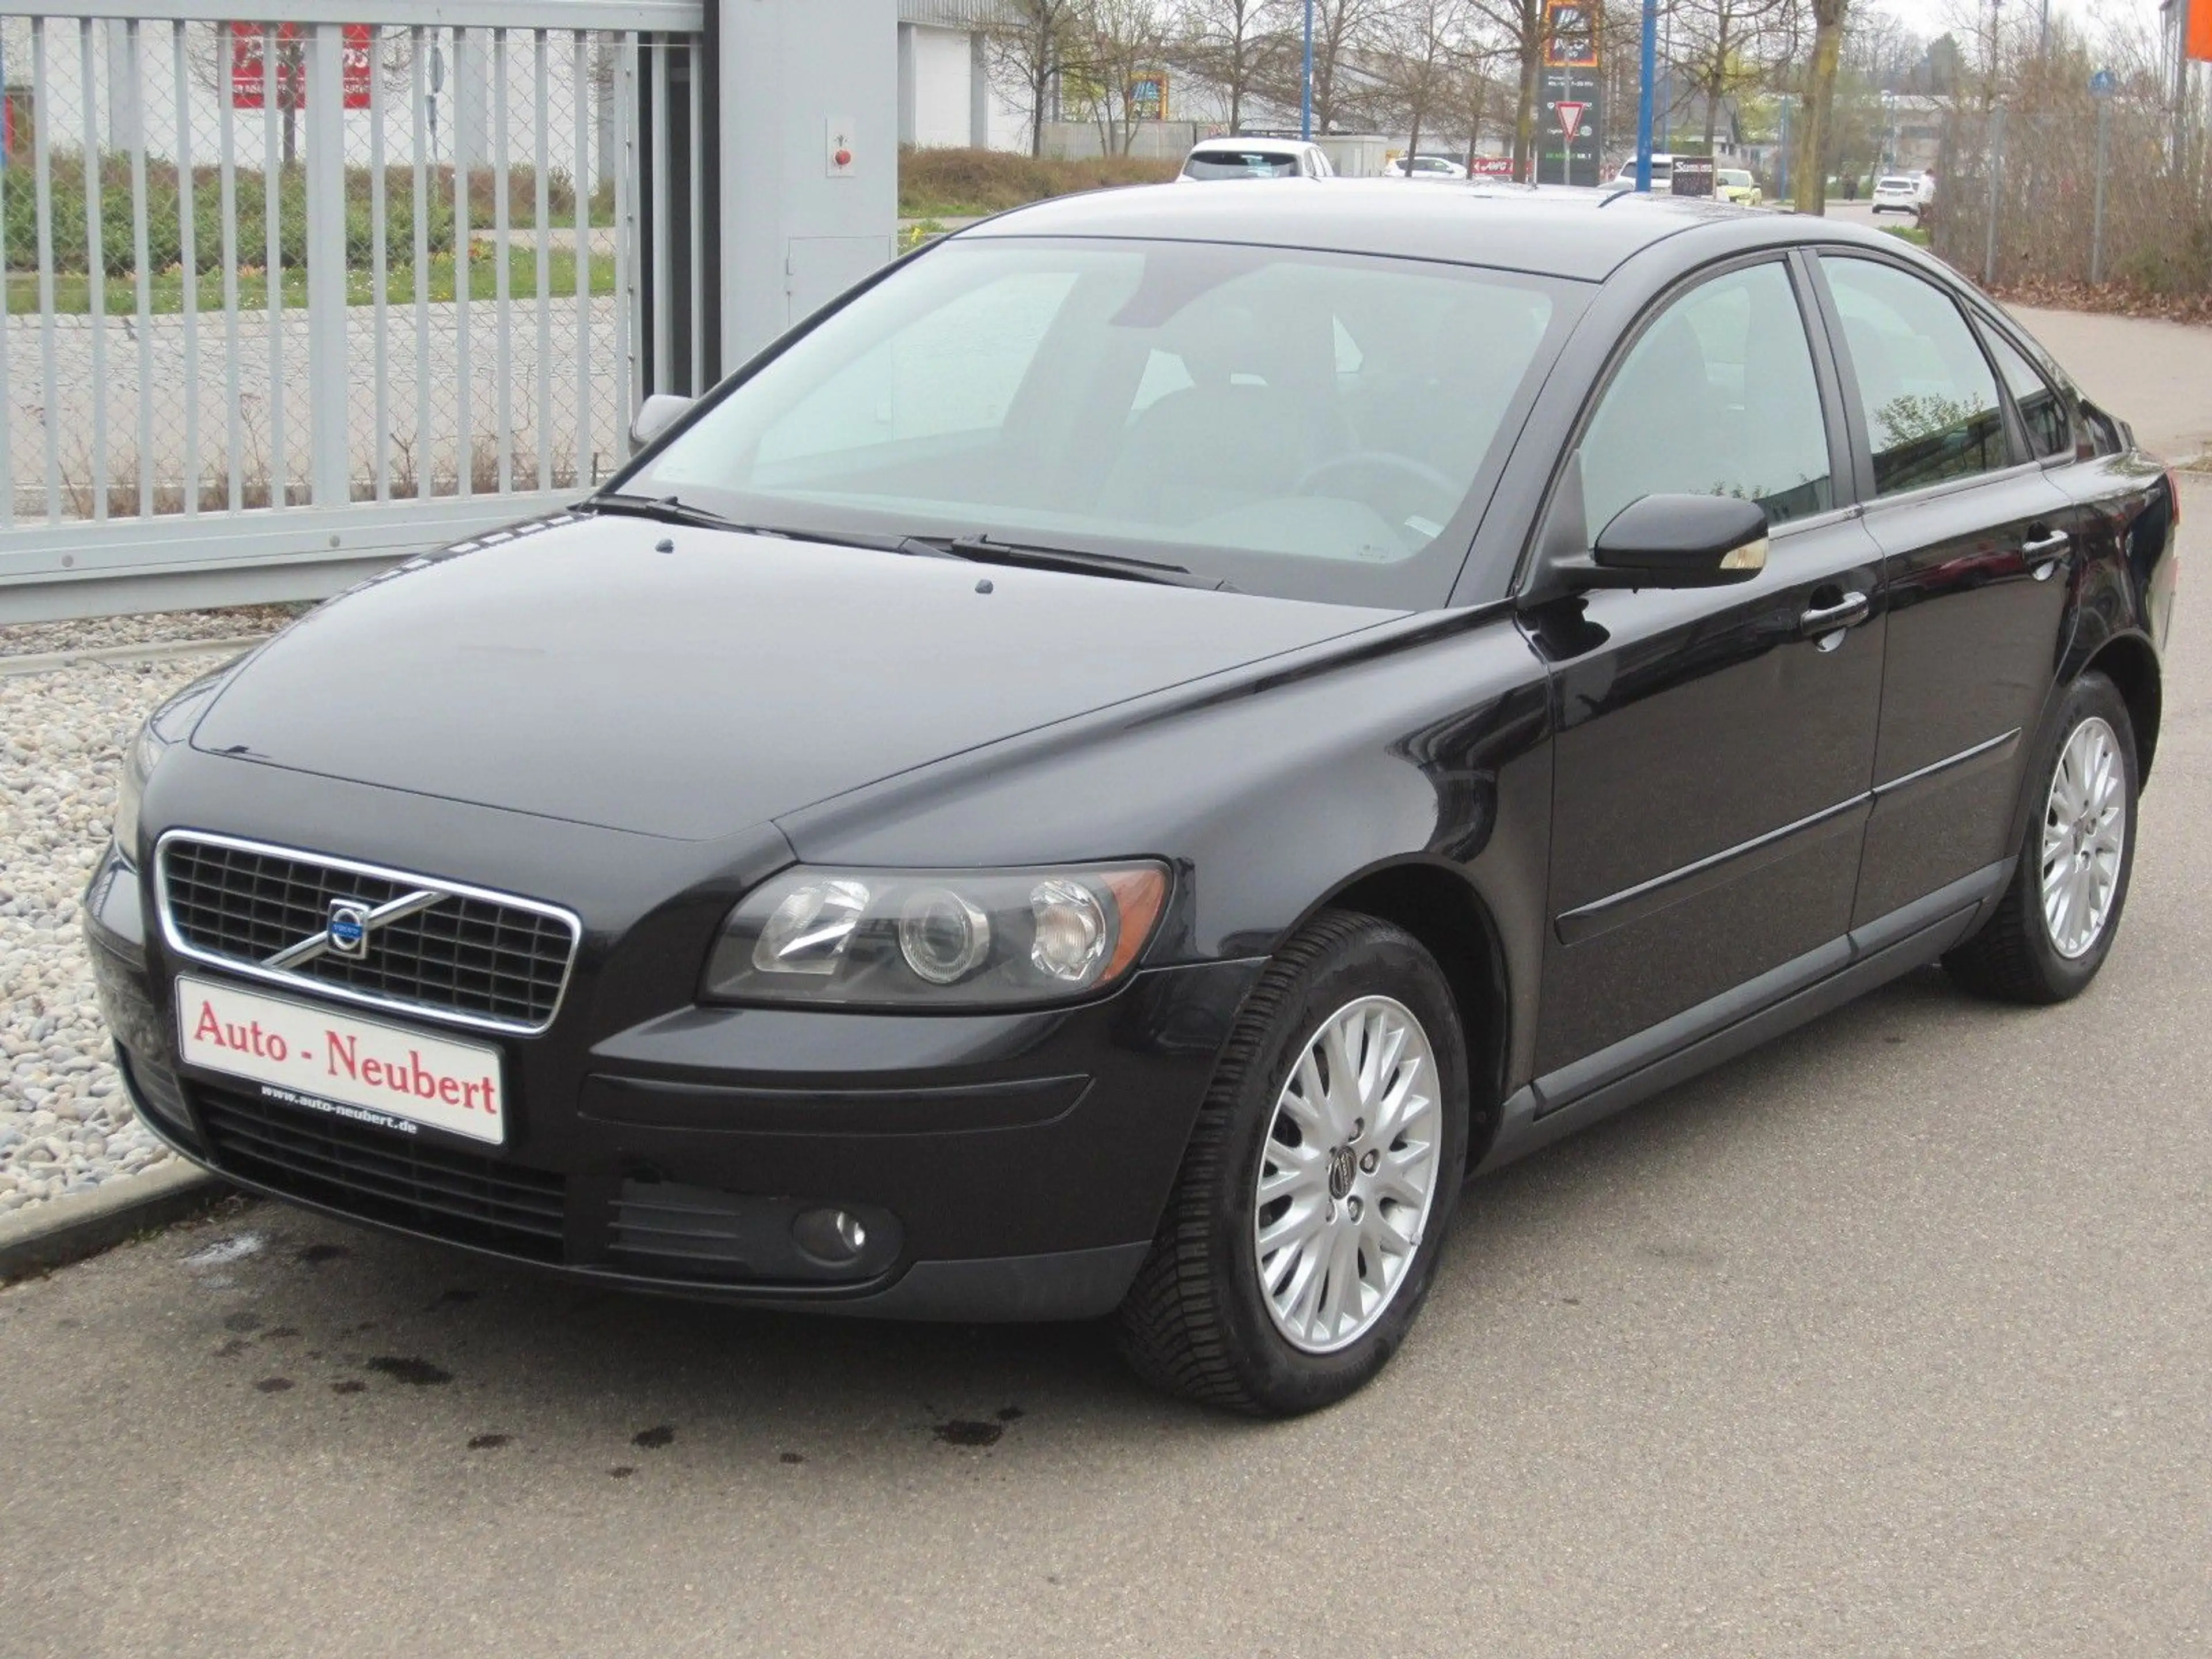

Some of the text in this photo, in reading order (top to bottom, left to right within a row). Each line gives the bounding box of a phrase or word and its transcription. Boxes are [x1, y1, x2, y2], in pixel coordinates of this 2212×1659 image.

[193, 999, 287, 1062] Auto
[325, 1029, 497, 1115] Neubert
[261, 1085, 418, 1134] www.auto-neubert.de
